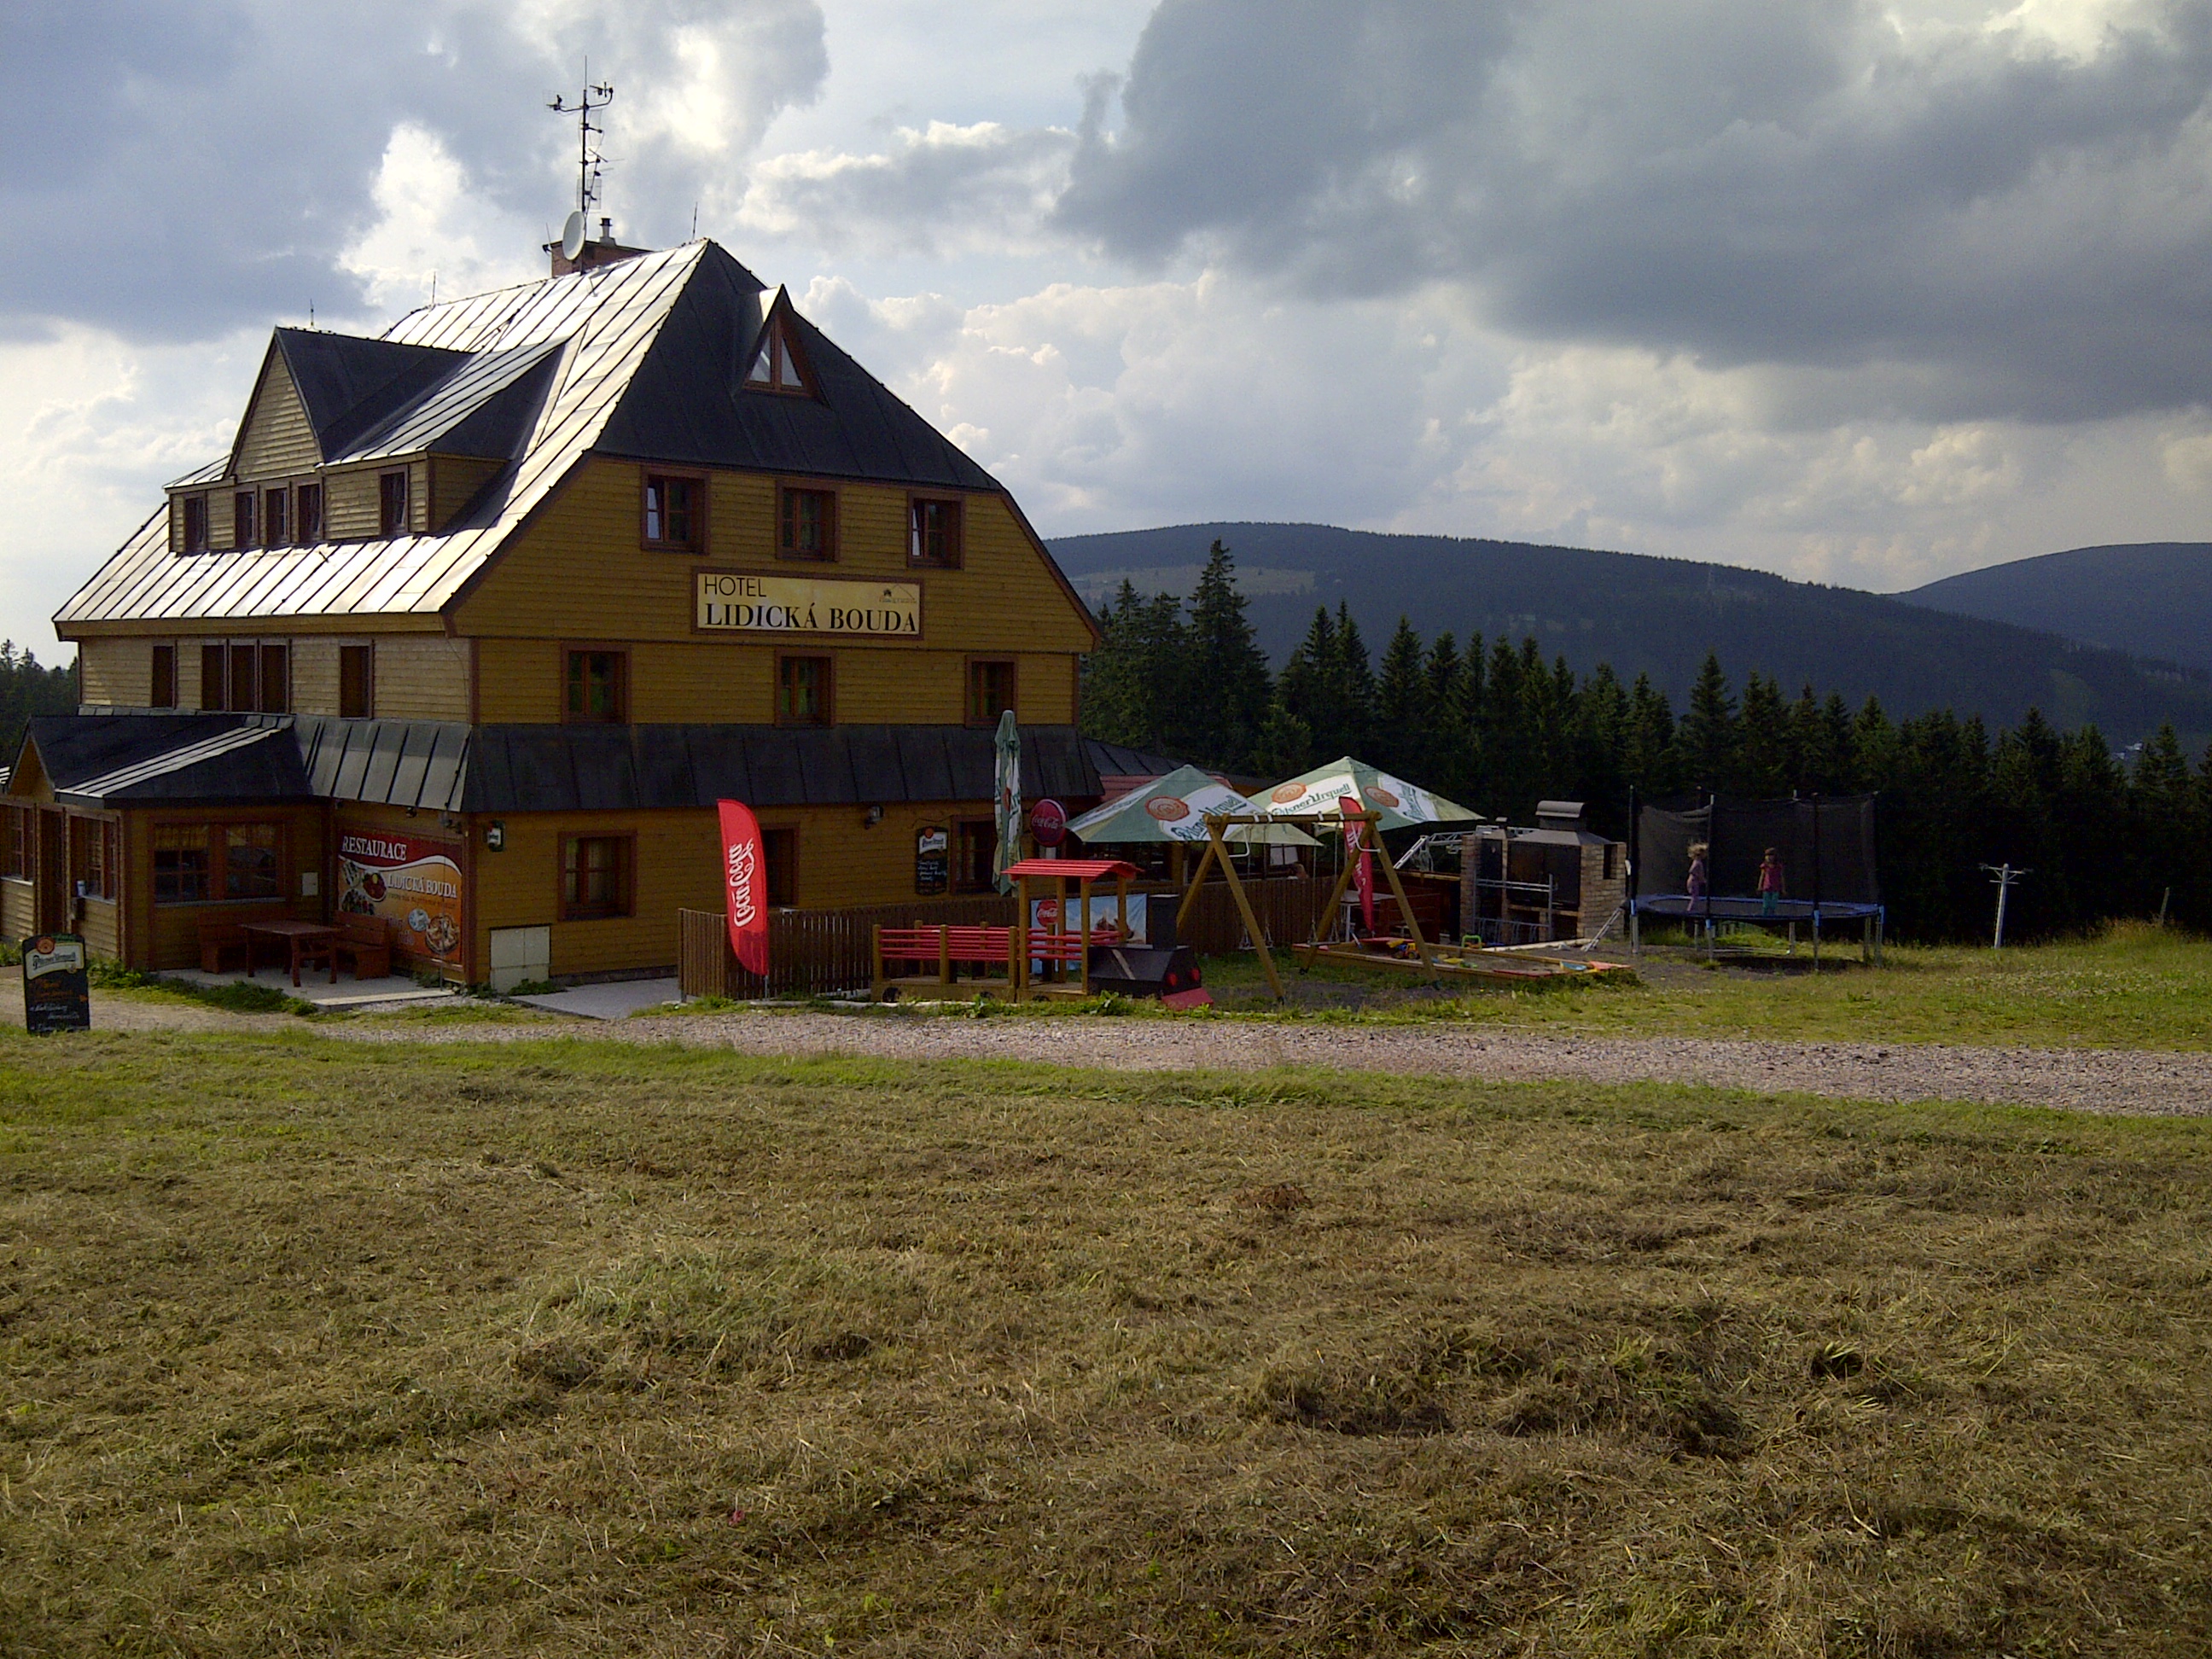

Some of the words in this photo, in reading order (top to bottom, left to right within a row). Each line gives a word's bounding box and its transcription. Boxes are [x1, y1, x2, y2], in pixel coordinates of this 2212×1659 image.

[704, 575, 766, 597] HOTEL
[705, 602, 818, 629] LIDICKÁ
[830, 608, 917, 632] BOUDA
[1308, 783, 1351, 803] Urquell
[341, 835, 408, 862] RESTAURACE
[387, 874, 425, 894] LIDICKÁ
[427, 878, 457, 899] BOUDA
[728, 838, 756, 928] Coca-Cola
